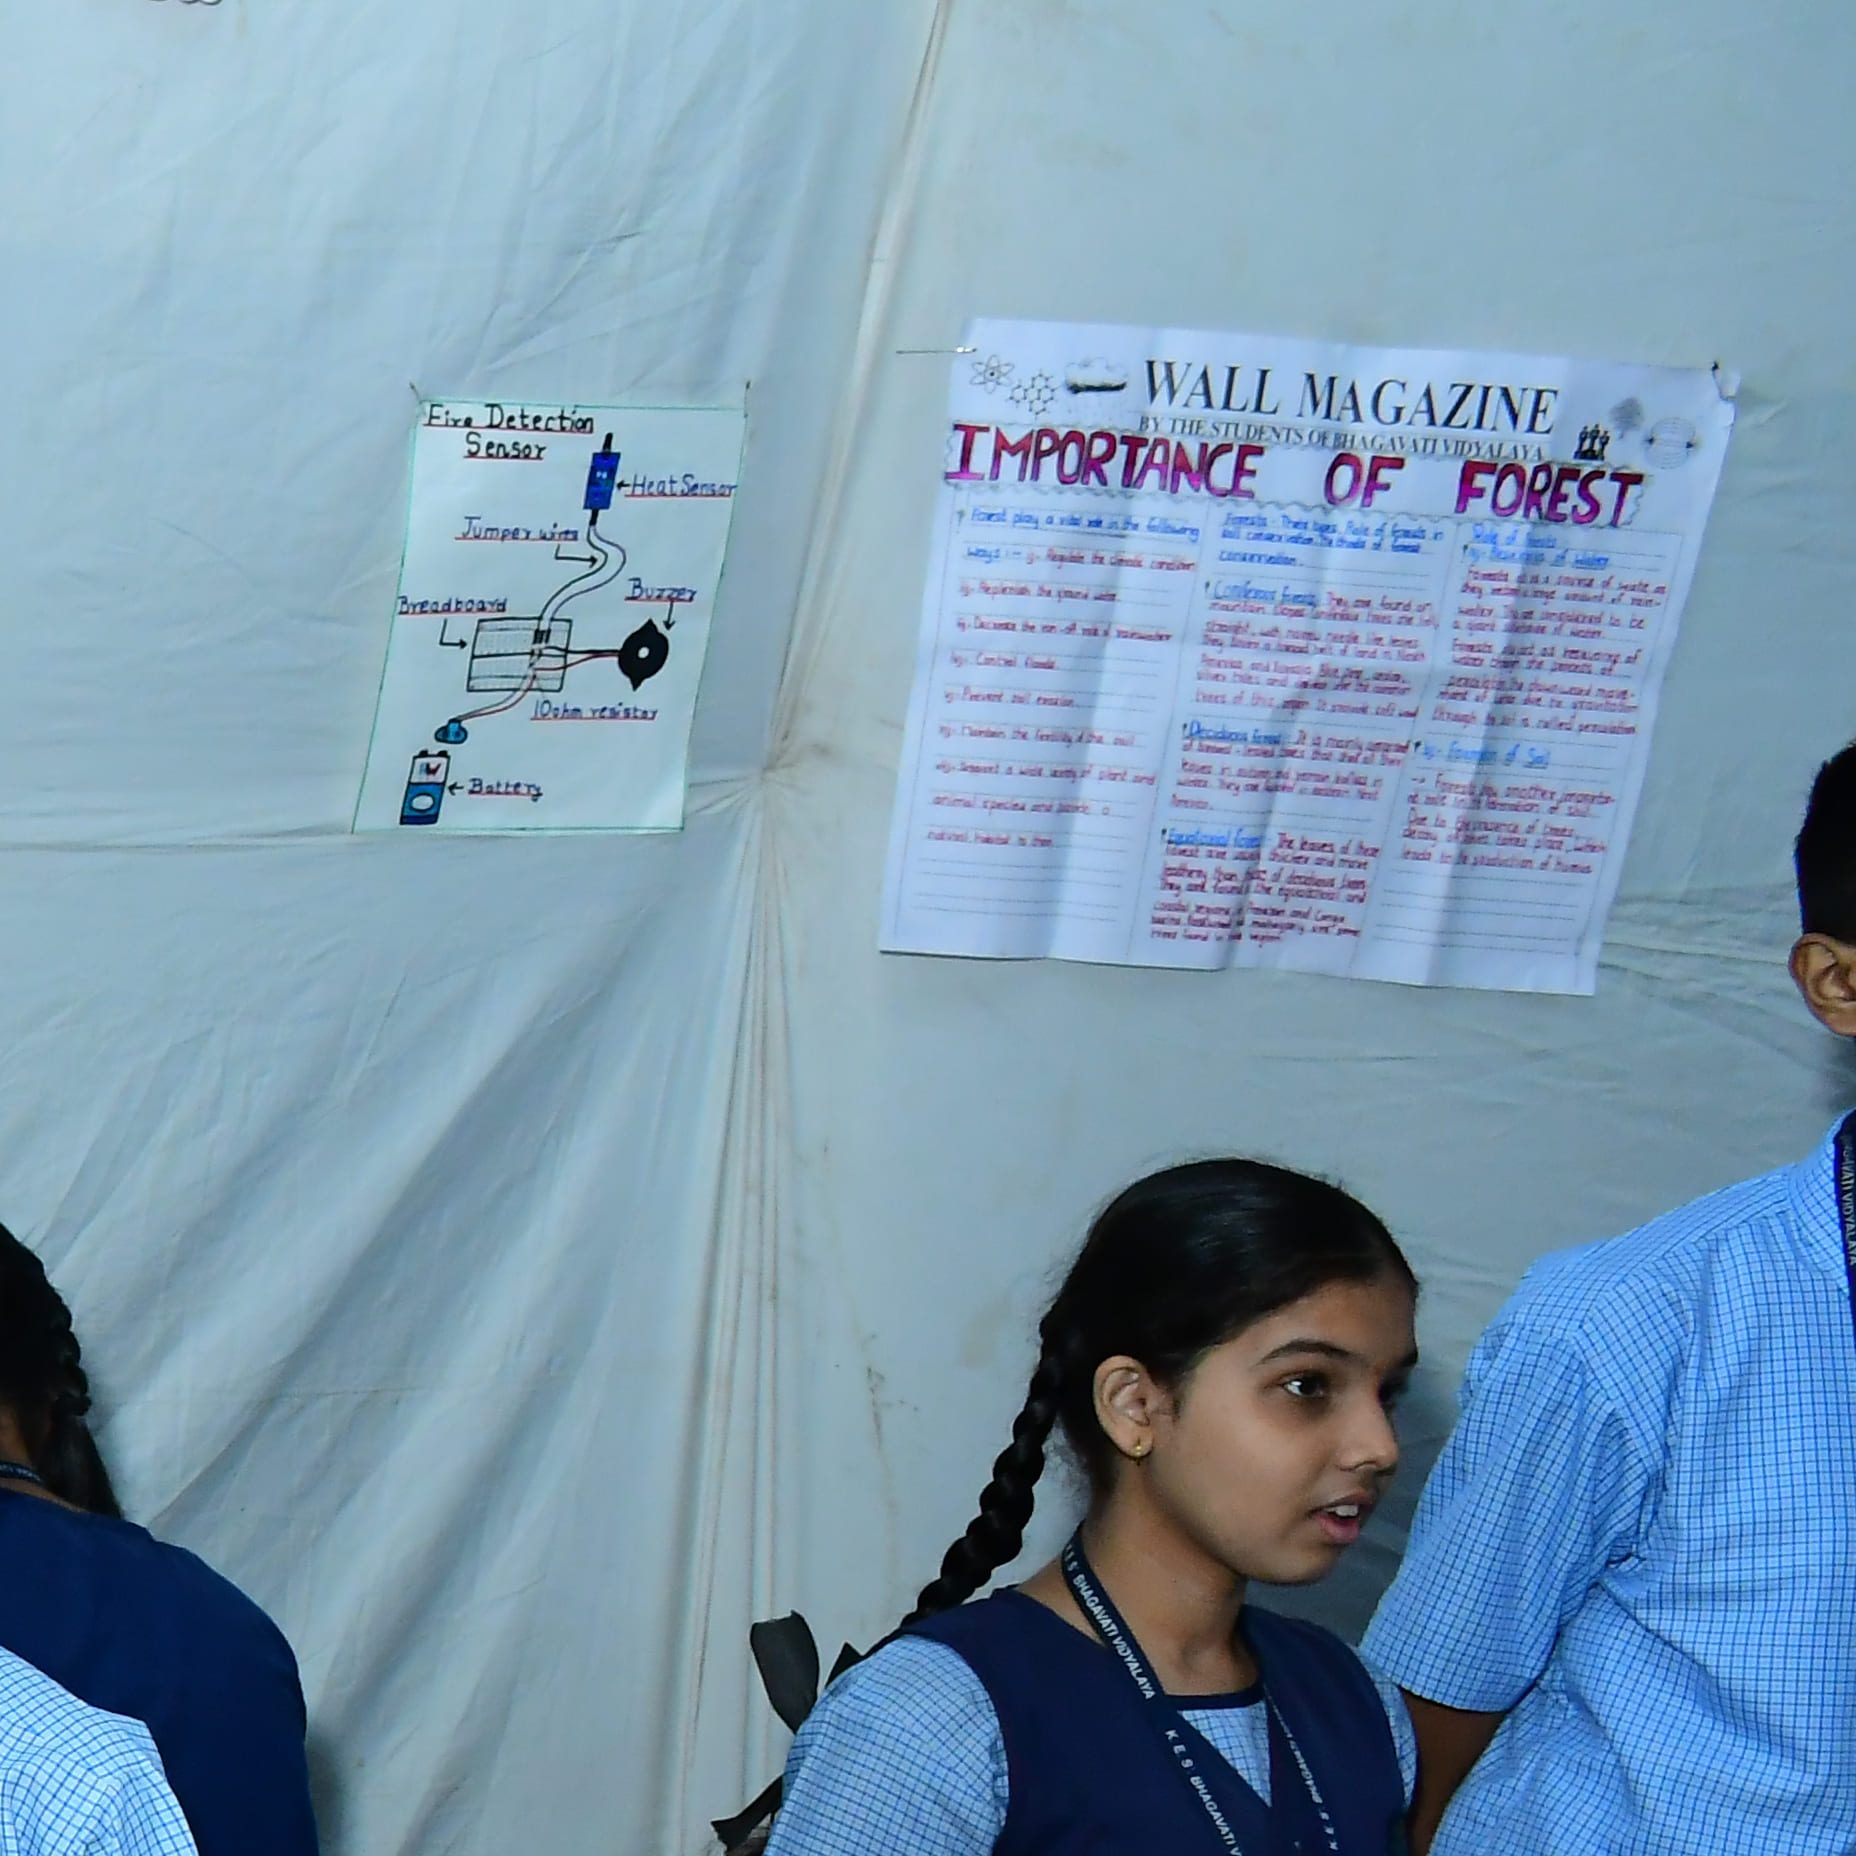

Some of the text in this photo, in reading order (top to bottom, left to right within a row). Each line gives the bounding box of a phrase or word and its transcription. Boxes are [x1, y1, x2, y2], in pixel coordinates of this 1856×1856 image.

[1146, 359, 1559, 435] WALL MAGAZINE
[424, 403, 595, 434] Fire Detection
[465, 432, 548, 460] Sensor
[1139, 415, 1163, 433] BY
[1170, 417, 1205, 437] THE
[1210, 420, 1304, 446] STUDENTS
[1333, 431, 1439, 455] BHAGAVATI
[1442, 439, 1545, 462] VIDYALAYA
[944, 422, 1645, 529] IMPORTANCE OF FOREST
[460, 516, 532, 542] Jumper
[397, 595, 508, 614] Breadboard
[627, 577, 699, 603] Buzzer
[468, 777, 545, 803] Battery
[1072, 1573, 1157, 1701] BHAGAVATI VIDYALAYA
[1189, 1774, 1236, 1846] BHAGAVATI
